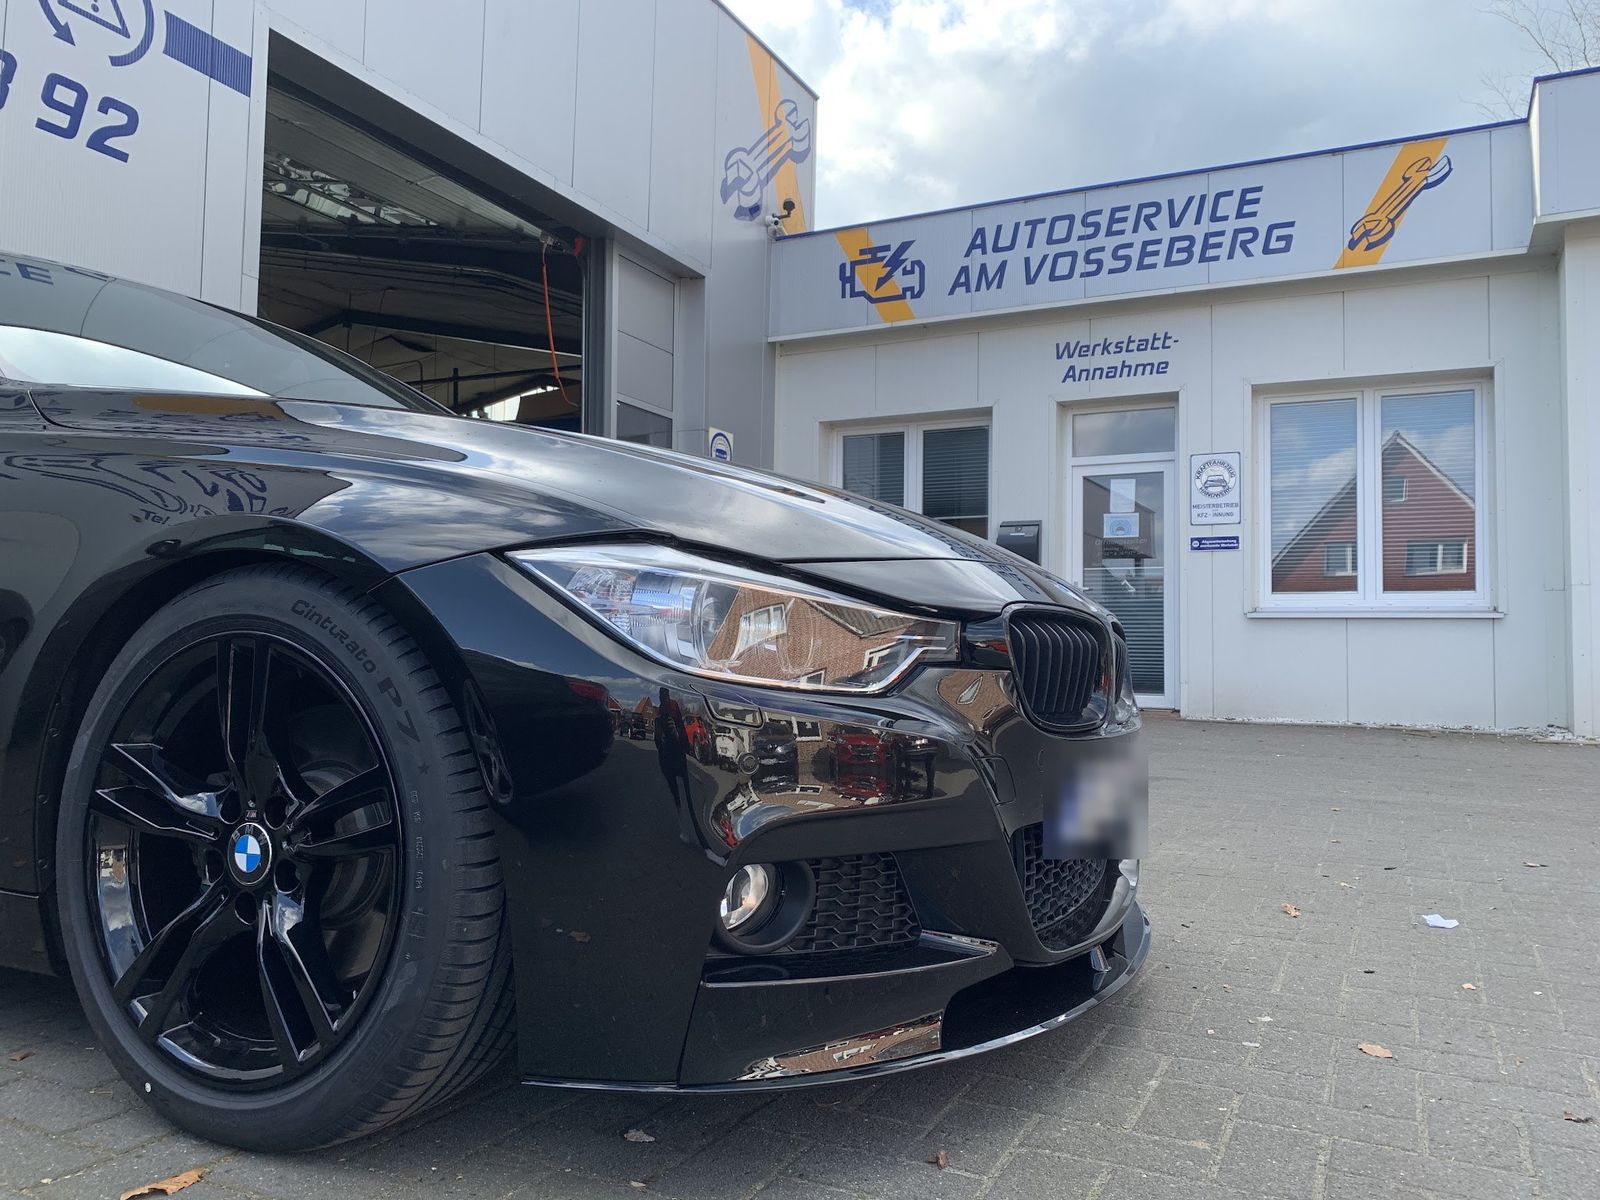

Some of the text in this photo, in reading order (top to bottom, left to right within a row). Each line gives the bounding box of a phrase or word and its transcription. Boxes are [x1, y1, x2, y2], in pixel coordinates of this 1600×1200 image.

[35, 73, 139, 163] 92
[963, 185, 1264, 258] AUTOSERVICE
[948, 220, 1296, 296] AM VOSSEBERG
[1055, 331, 1179, 360] Werkstatt-
[1061, 360, 1169, 383] Annahme
[1195, 459, 1236, 480] KRAFTFAHRZEUG
[1199, 486, 1232, 499] HANDWERK
[290, 598, 378, 675] Cinturato
[377, 676, 421, 744] P7
[232, 824, 269, 846] BMW
